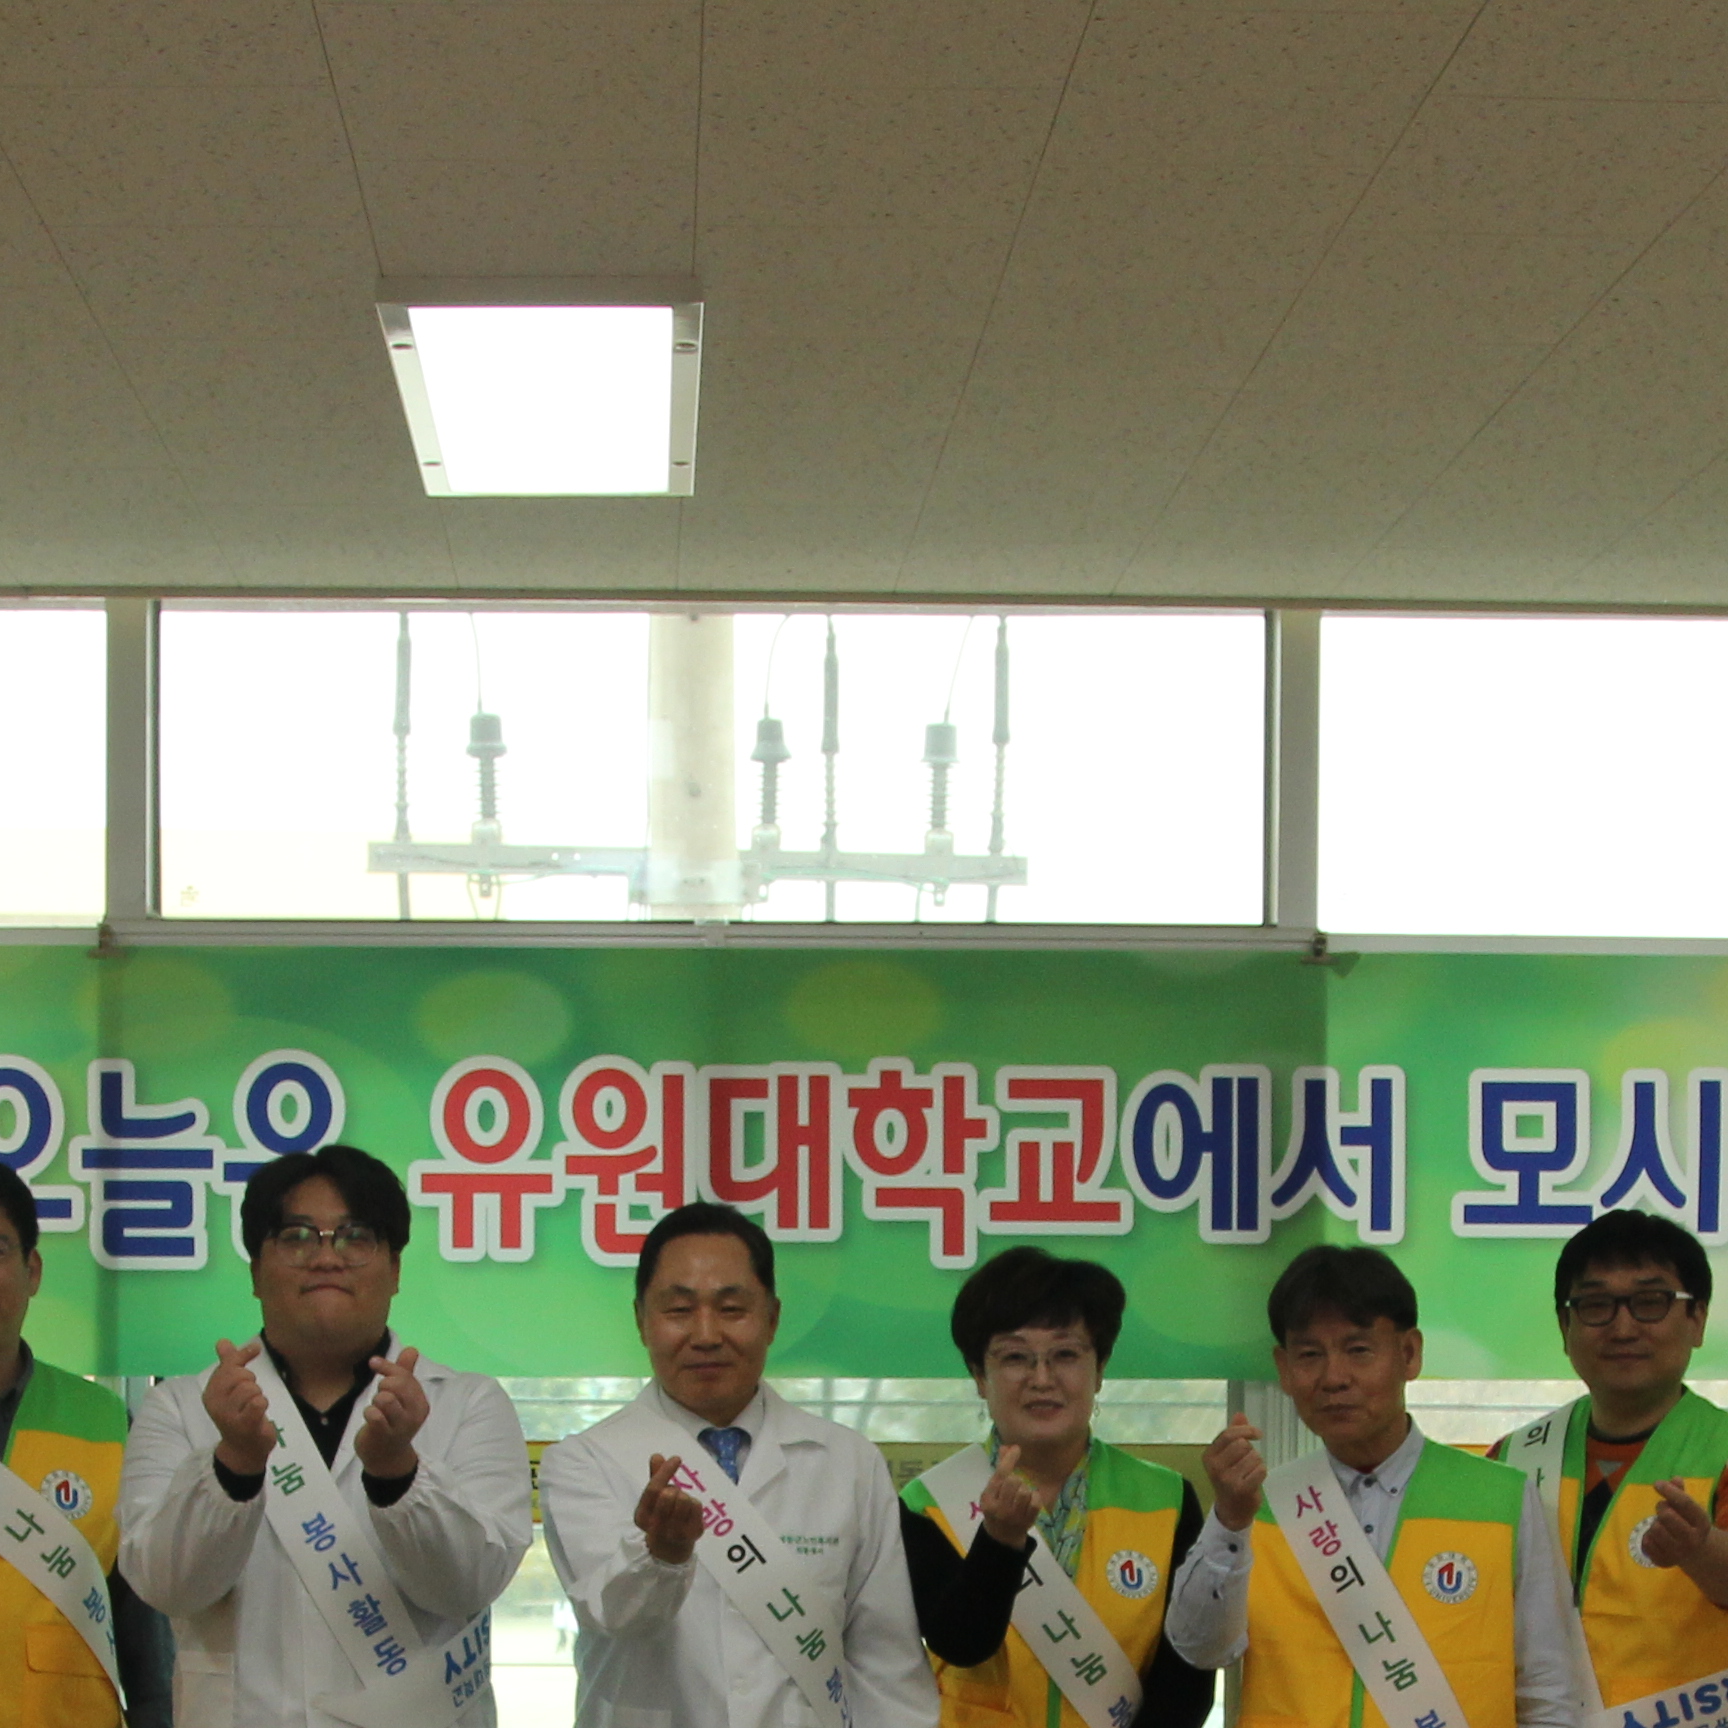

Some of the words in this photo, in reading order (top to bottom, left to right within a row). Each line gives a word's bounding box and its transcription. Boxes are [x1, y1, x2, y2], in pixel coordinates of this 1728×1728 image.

[420, 1067, 1393, 1258] 유원대학교에서
[3, 1508, 77, 1580] 나눔
[301, 1511, 408, 1677] 봉사활동
[1294, 1485, 1365, 1594] 사랑의
[1358, 1610, 1419, 1693] 나눔
[766, 1587, 828, 1662] 나눔
[1041, 1608, 1109, 1687] 나눔
